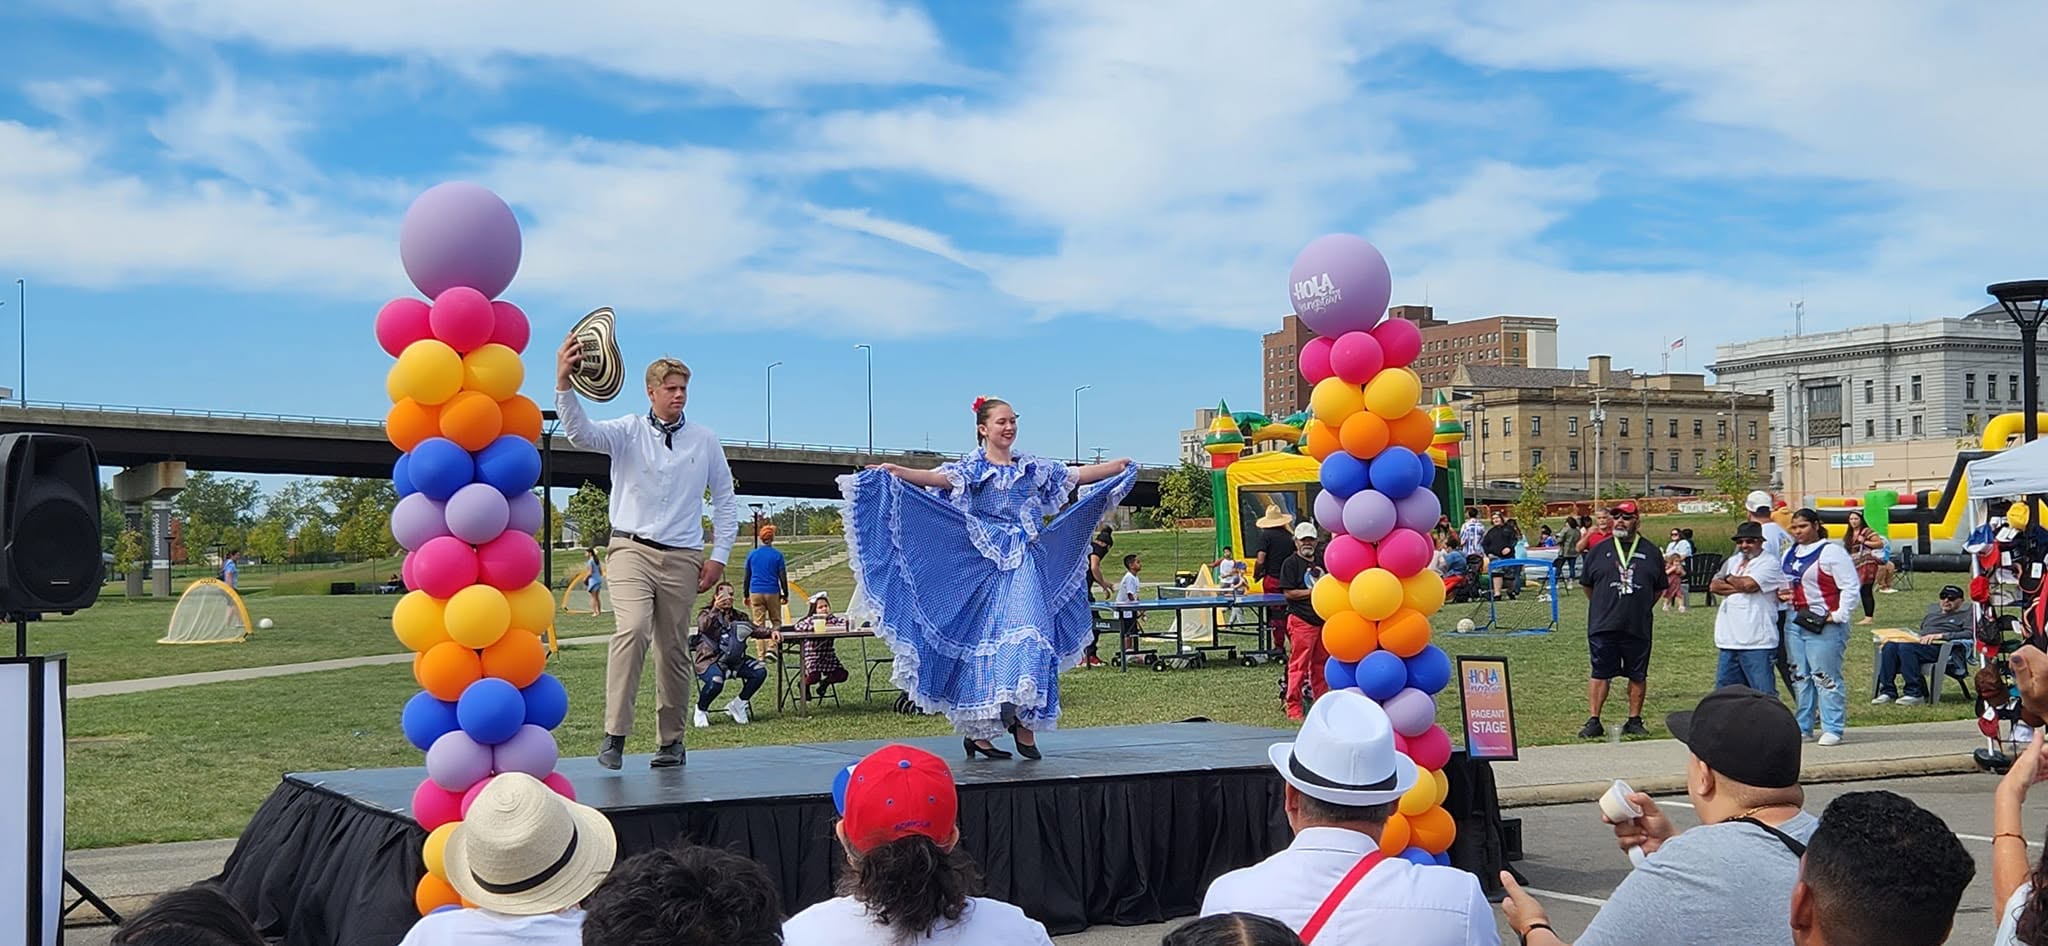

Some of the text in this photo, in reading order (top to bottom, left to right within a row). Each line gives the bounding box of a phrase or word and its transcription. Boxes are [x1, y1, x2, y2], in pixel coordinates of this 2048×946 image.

[1294, 273, 1335, 300] HOLA
[1832, 454, 1865, 463] TMLIN
[1468, 668, 1499, 685] HOLA
[1470, 709, 1505, 719] PAGEANT
[1472, 721, 1508, 734] STAGE
